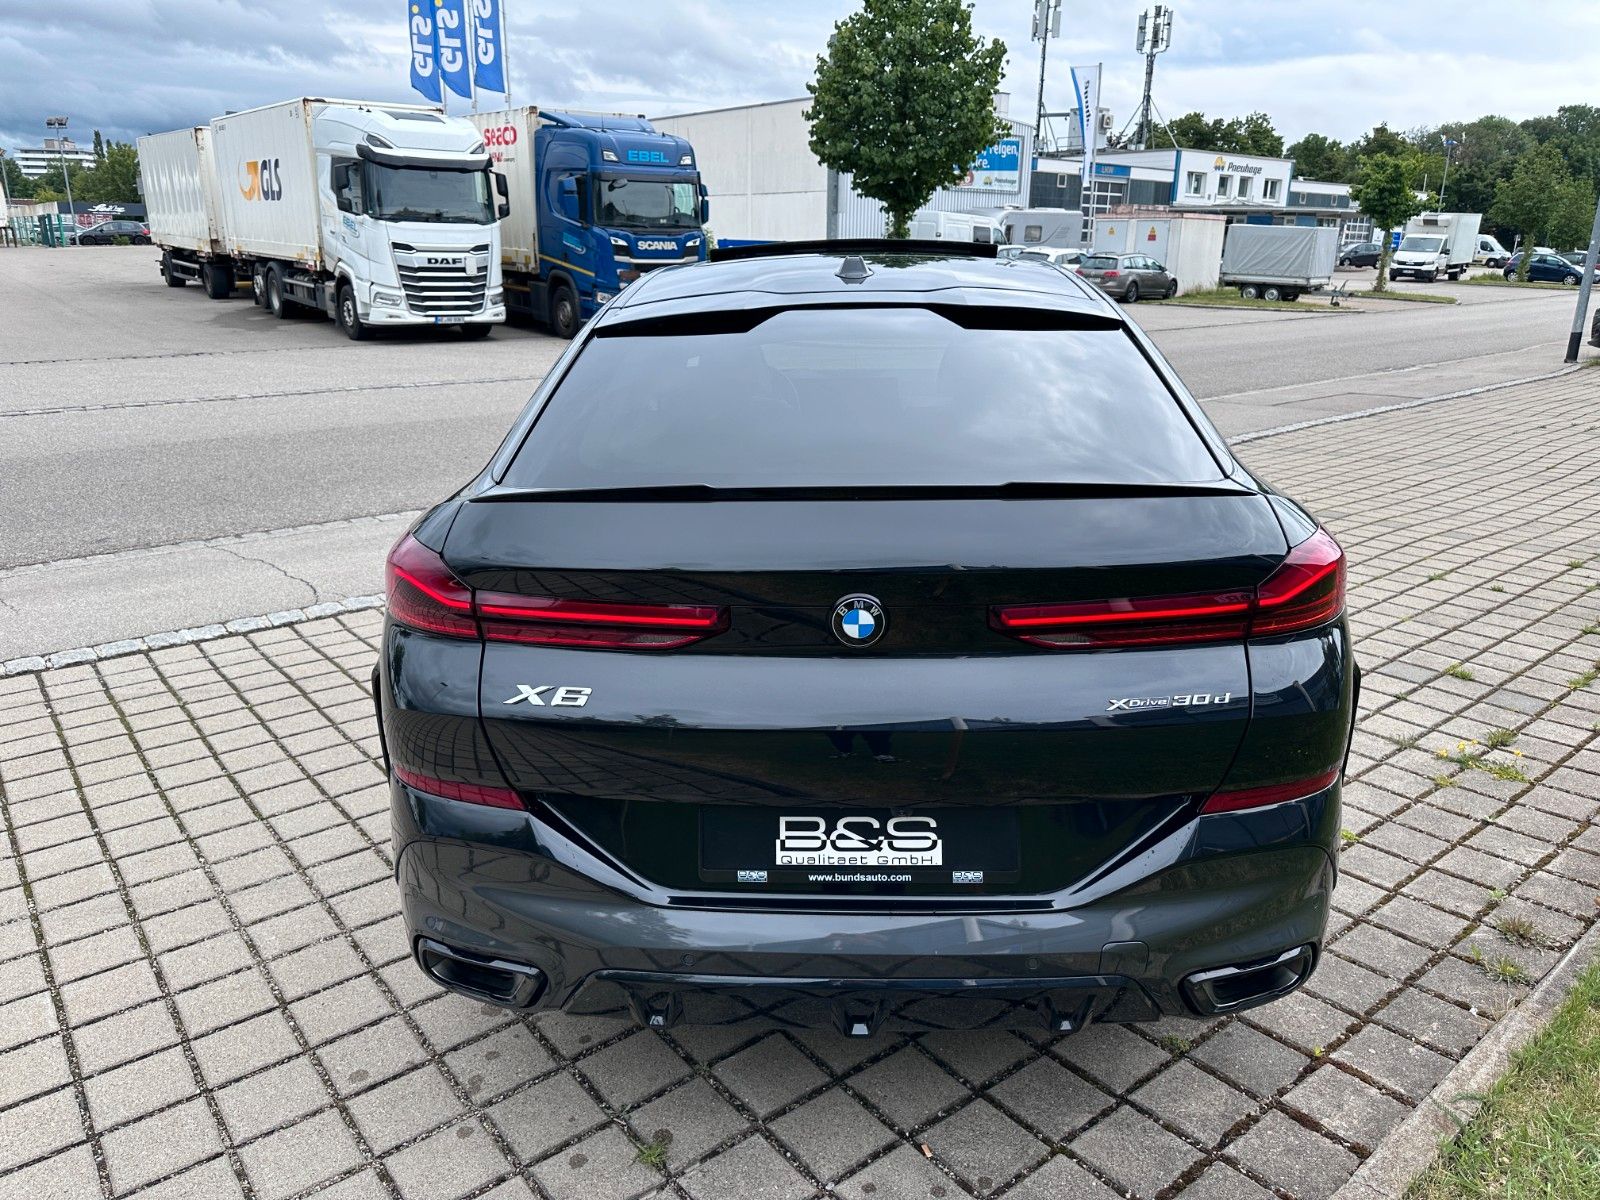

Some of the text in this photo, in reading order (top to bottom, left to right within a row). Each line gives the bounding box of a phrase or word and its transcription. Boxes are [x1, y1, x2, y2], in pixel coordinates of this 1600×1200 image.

[627, 150, 670, 163] EBEL
[1227, 162, 1263, 176] Pneuhage
[260, 158, 282, 201] GLS
[637, 241, 678, 251] SCANIA
[427, 257, 463, 265] DAF
[838, 600, 880, 616] BMW
[502, 684, 593, 707] X6
[779, 816, 939, 852] B&S
[780, 853, 869, 865] Qualitaet
[808, 873, 912, 882] www.bundsauto.com
